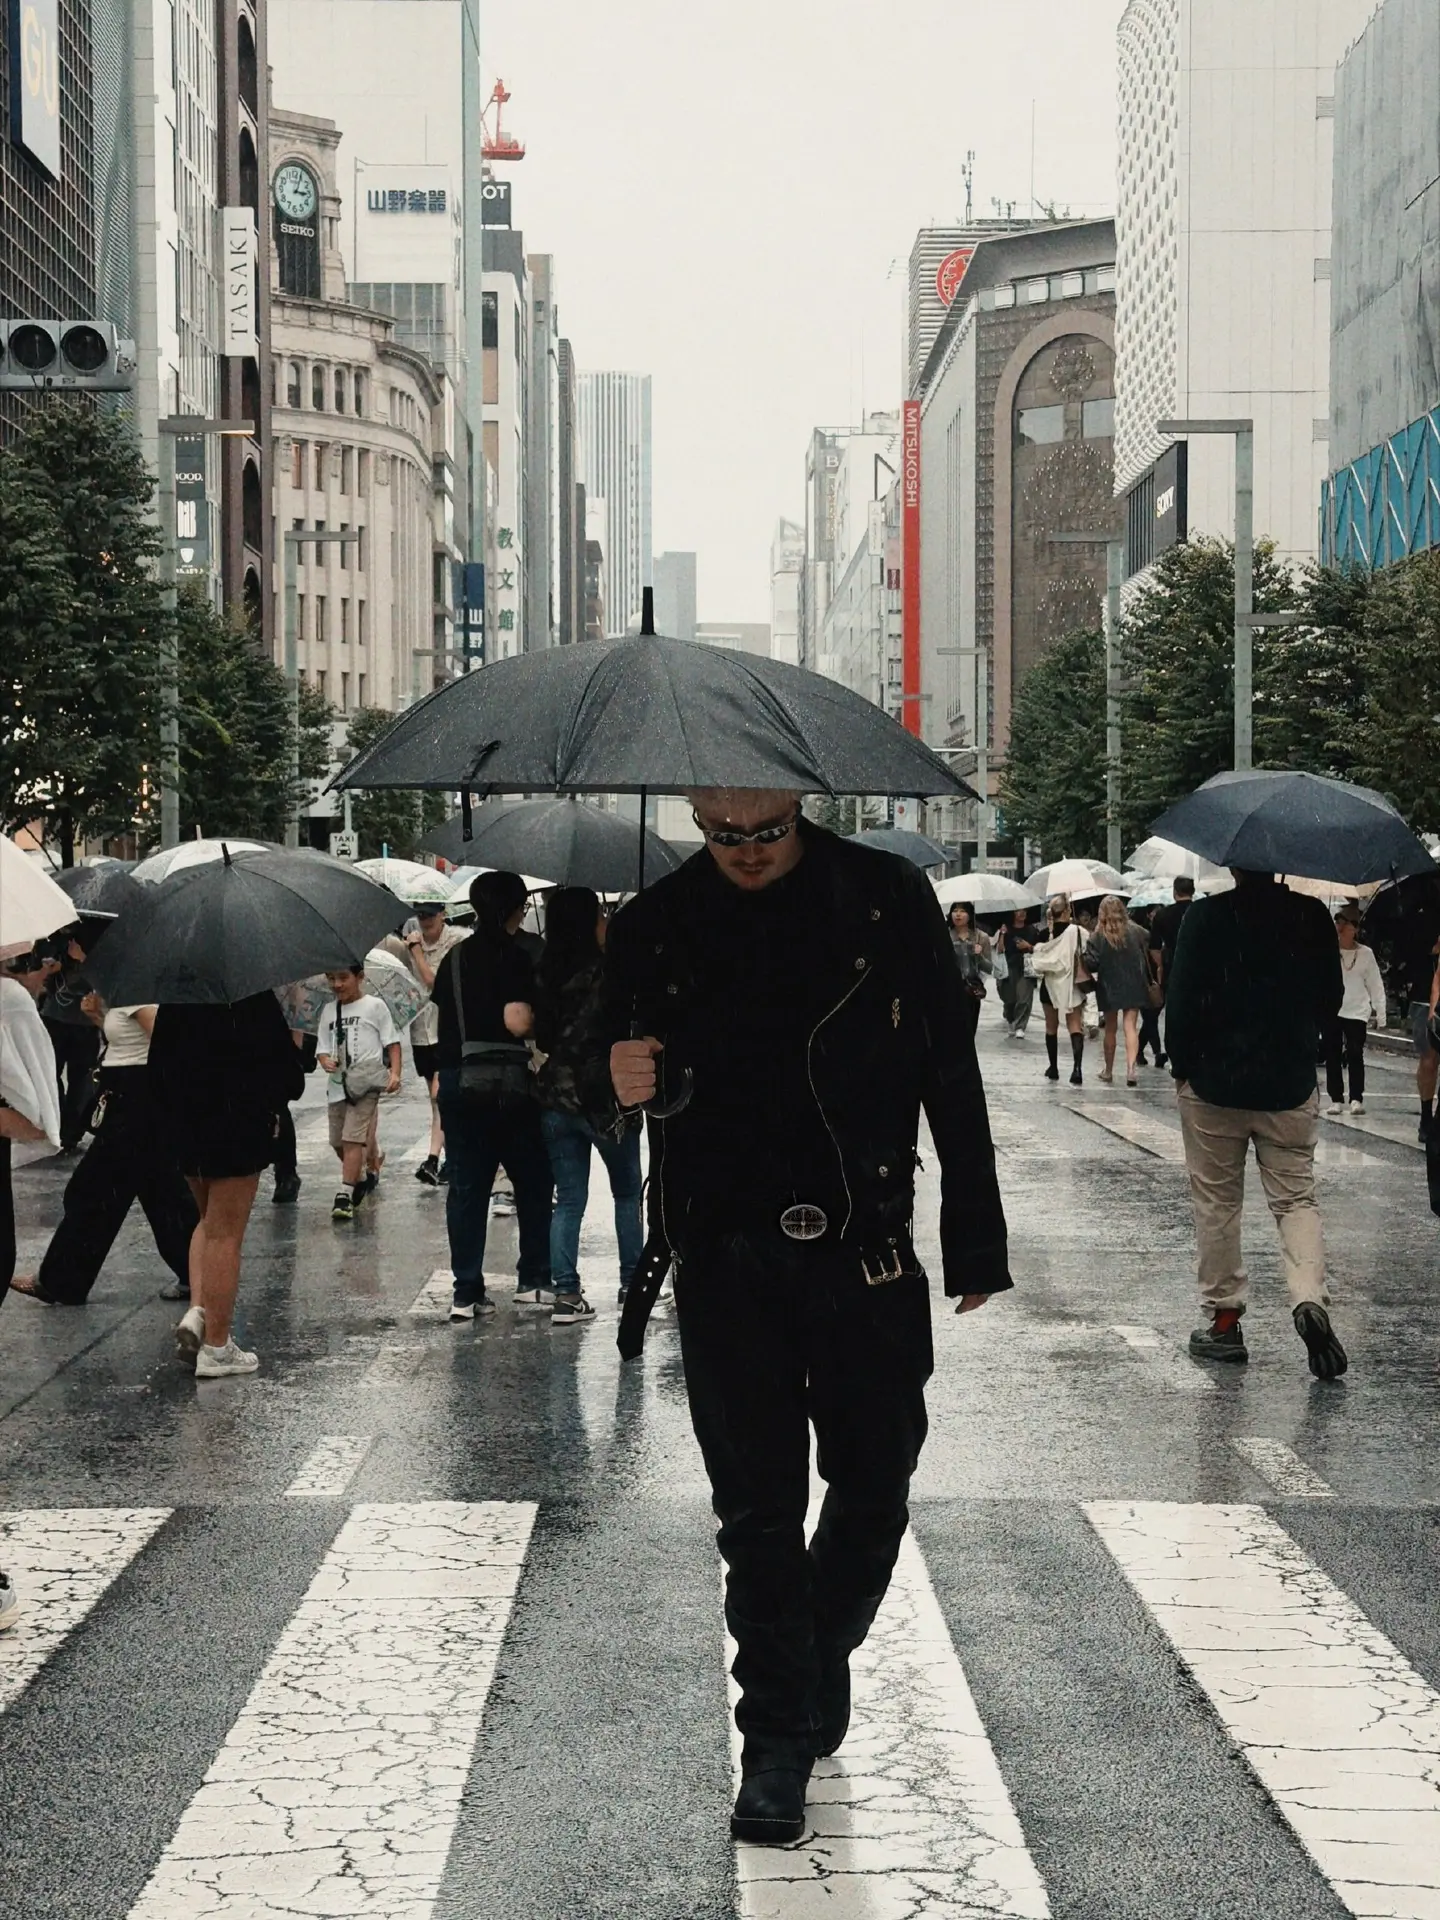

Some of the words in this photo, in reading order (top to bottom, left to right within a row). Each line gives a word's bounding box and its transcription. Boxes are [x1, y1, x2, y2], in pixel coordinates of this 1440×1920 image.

[22, 6, 58, 118] GU
[367, 189, 447, 212] 山野楽器
[481, 185, 508, 200] OT
[286, 200, 292, 210] 7
[292, 204, 298, 214] 6
[280, 223, 315, 238] SEIKO
[230, 226, 249, 340] TASAKI
[906, 407, 918, 508] MITSUKOSHI
